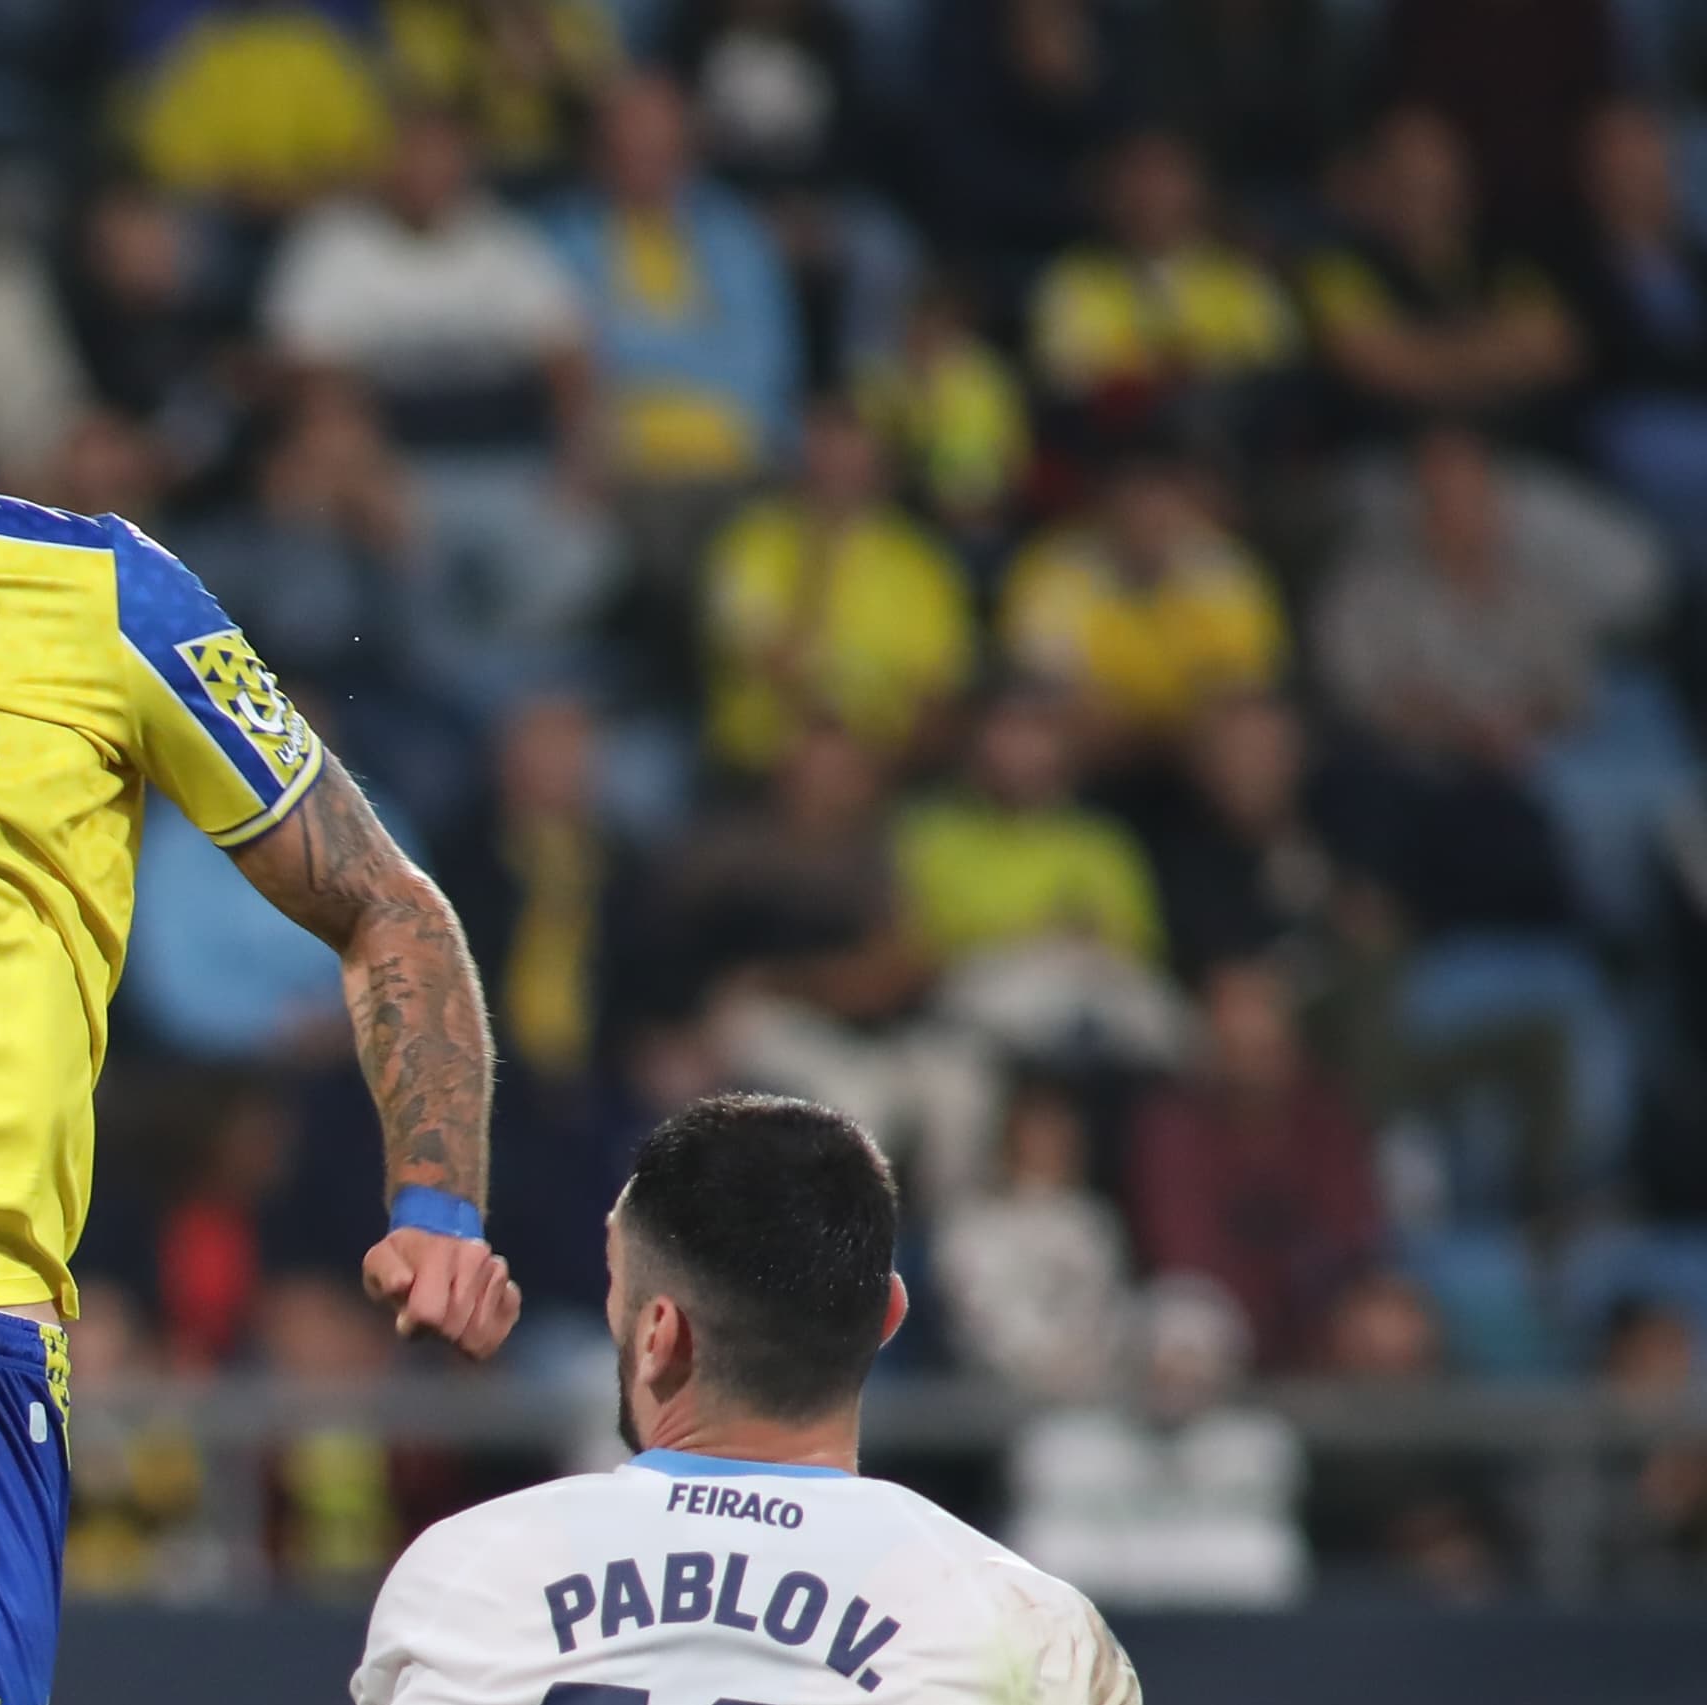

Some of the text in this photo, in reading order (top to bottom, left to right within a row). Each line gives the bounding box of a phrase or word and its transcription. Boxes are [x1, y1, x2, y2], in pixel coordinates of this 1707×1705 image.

[666, 1482, 804, 1530] FEIRACO
[543, 1550, 902, 1694] PABLO V.
